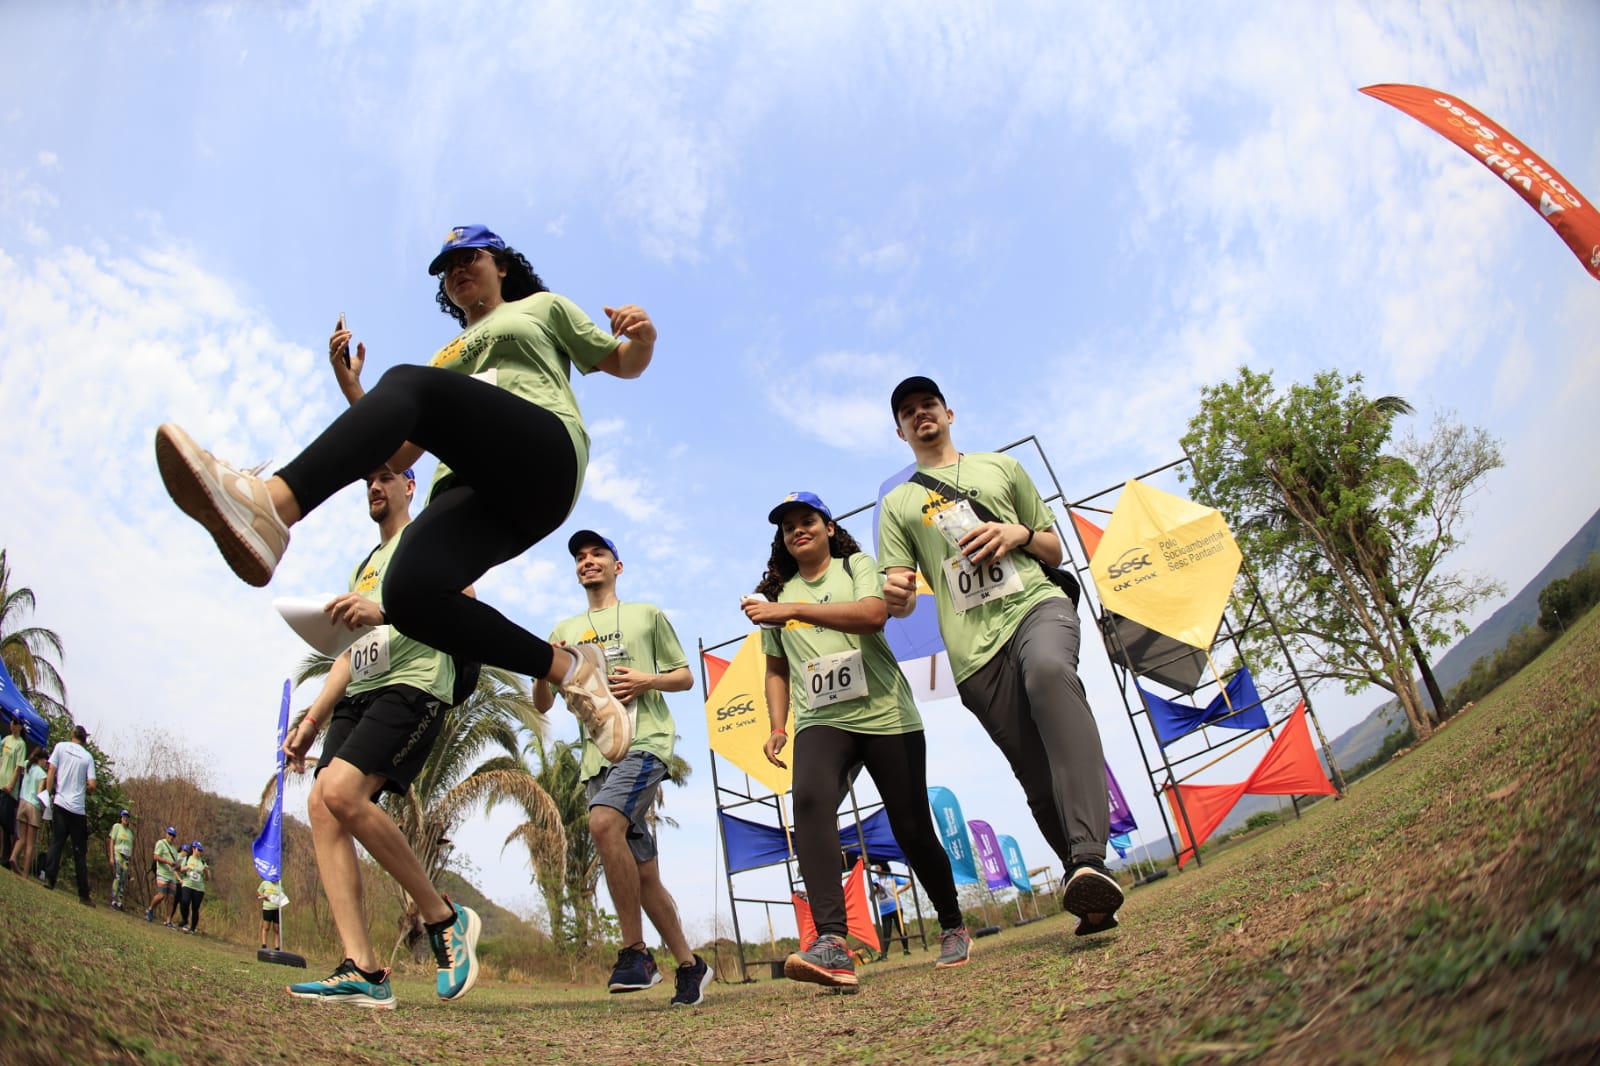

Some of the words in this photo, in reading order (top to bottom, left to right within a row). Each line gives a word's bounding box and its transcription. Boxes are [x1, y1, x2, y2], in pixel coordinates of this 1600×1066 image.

[1433, 97, 1500, 140] Sesc
[1502, 142, 1521, 155] o
[1473, 143, 1533, 191] vida
[1523, 158, 1582, 208] com
[1539, 191, 1566, 216] A
[460, 330, 490, 357] SESC
[1158, 537, 1178, 552] Polo
[1163, 530, 1225, 562] Socioambiental
[1167, 557, 1189, 572] Sesc
[1189, 541, 1224, 564] Pantanal
[958, 560, 1004, 594] 016
[1107, 551, 1152, 580] Sesc
[354, 641, 379, 670] 016
[812, 666, 851, 694] 016
[717, 698, 755, 721] Sesc
[391, 715, 431, 767] Reebok
